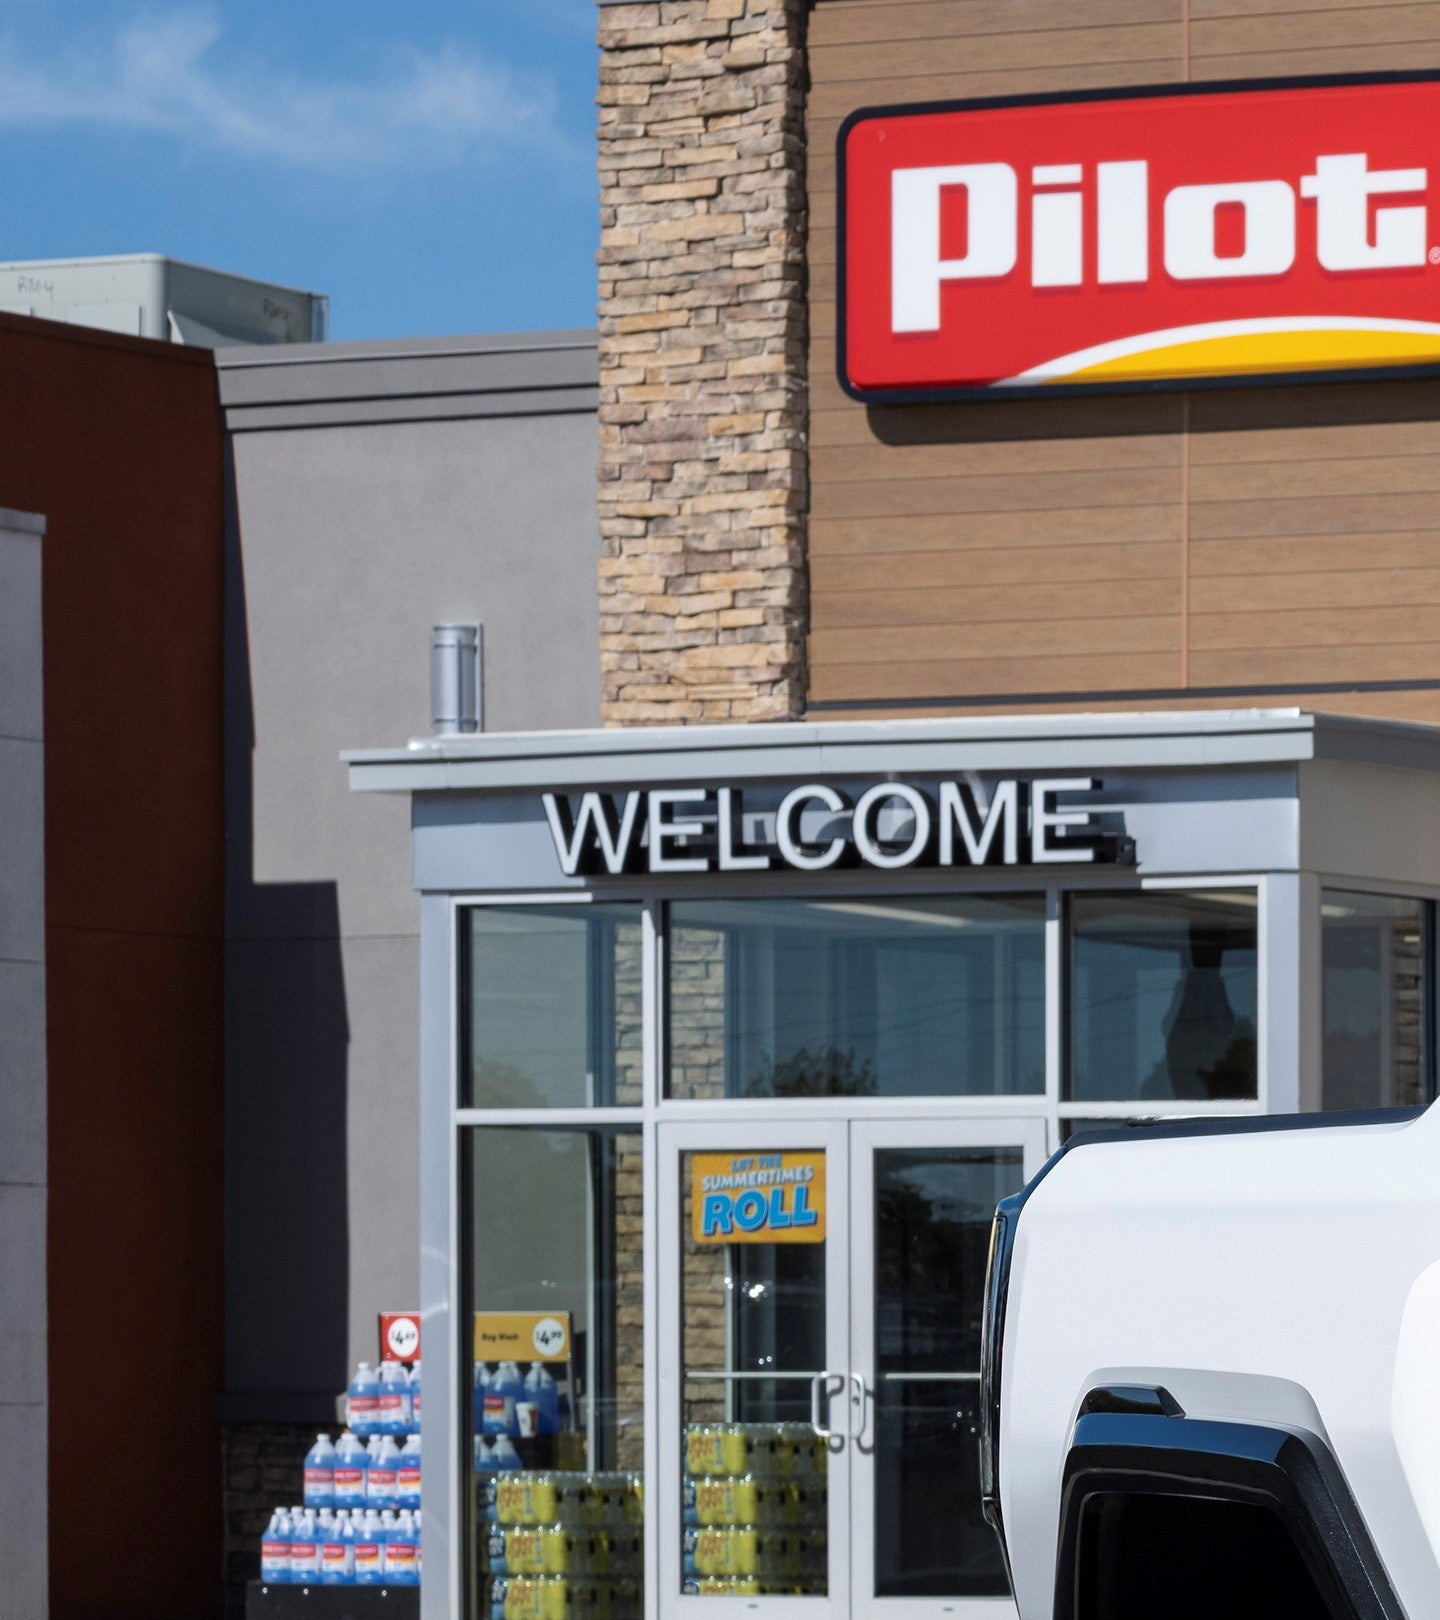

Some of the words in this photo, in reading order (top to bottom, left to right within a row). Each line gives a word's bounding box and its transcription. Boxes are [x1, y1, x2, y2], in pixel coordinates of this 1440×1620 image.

[541, 777, 1095, 876] WELCOME
[702, 1164, 813, 1192] SUMMERTIMES
[731, 1156, 754, 1171] LET
[702, 1184, 818, 1236] ROLL
